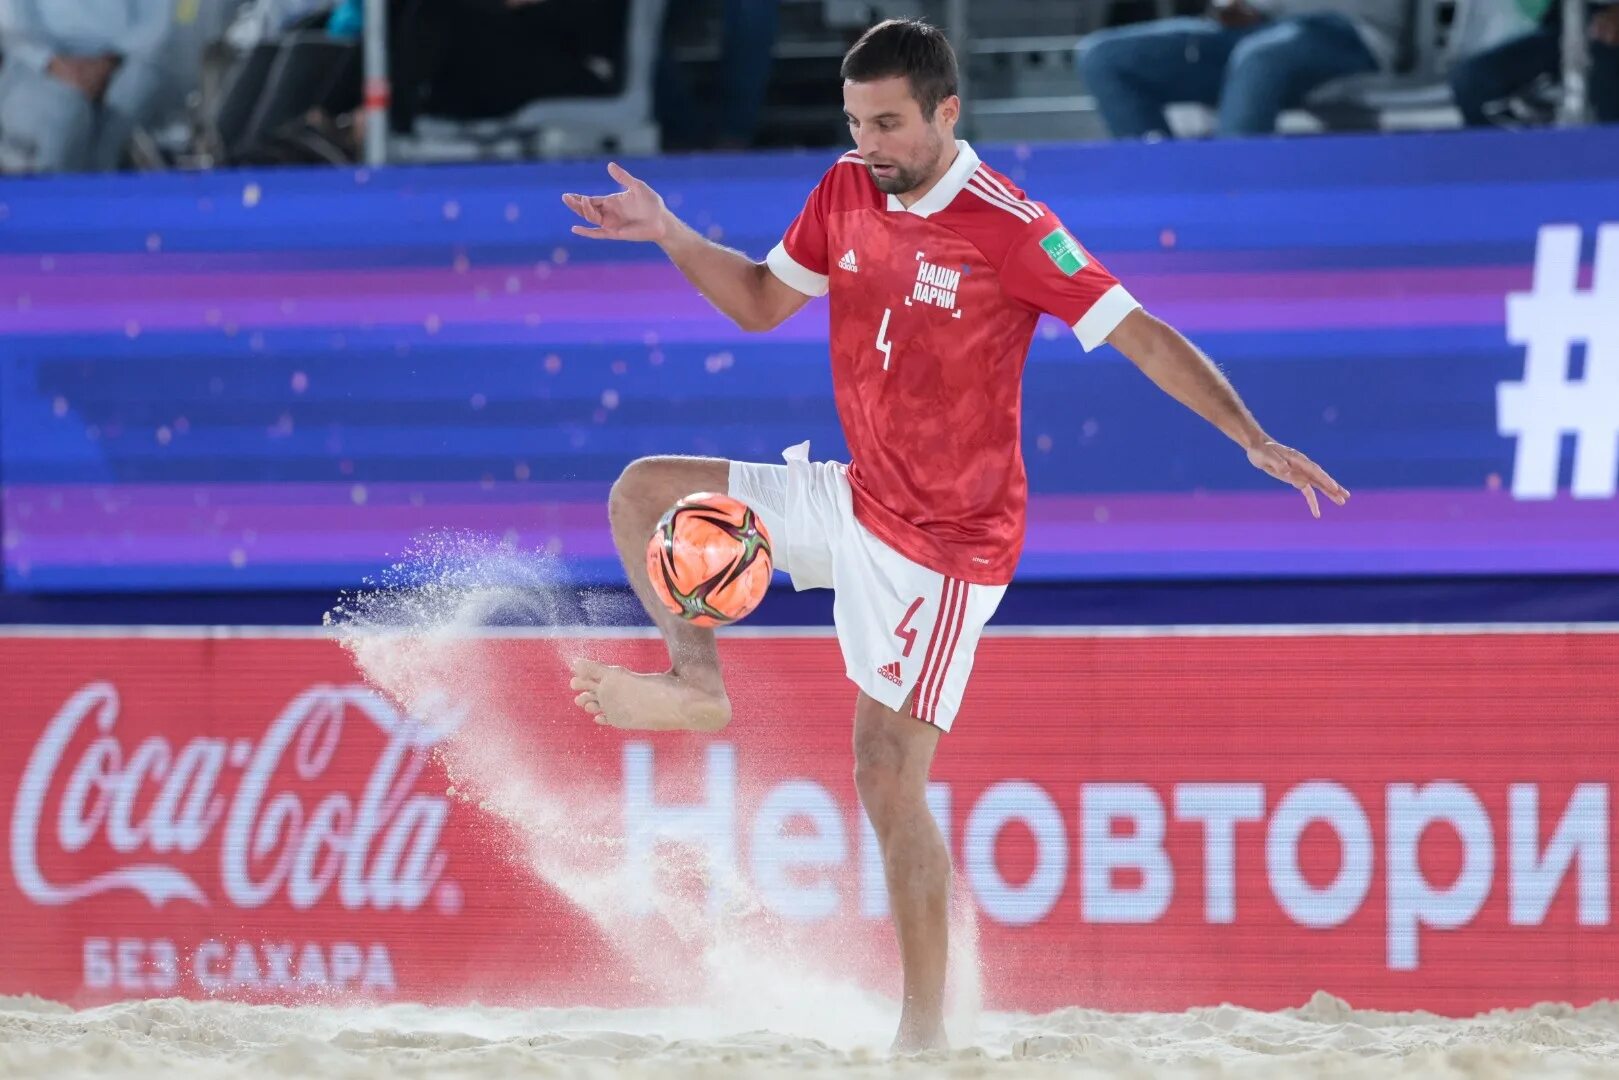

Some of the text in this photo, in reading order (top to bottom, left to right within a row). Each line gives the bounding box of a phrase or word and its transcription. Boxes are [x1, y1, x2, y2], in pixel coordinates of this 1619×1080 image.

[913, 285, 956, 309] ПАРНИ
[917, 262, 961, 291] НАШИ
[875, 308, 891, 370] 4
[894, 597, 925, 657] 4
[877, 667, 903, 687] adidas
[84, 937, 177, 989] БЕЗ
[194, 941, 396, 992] САХАРА
